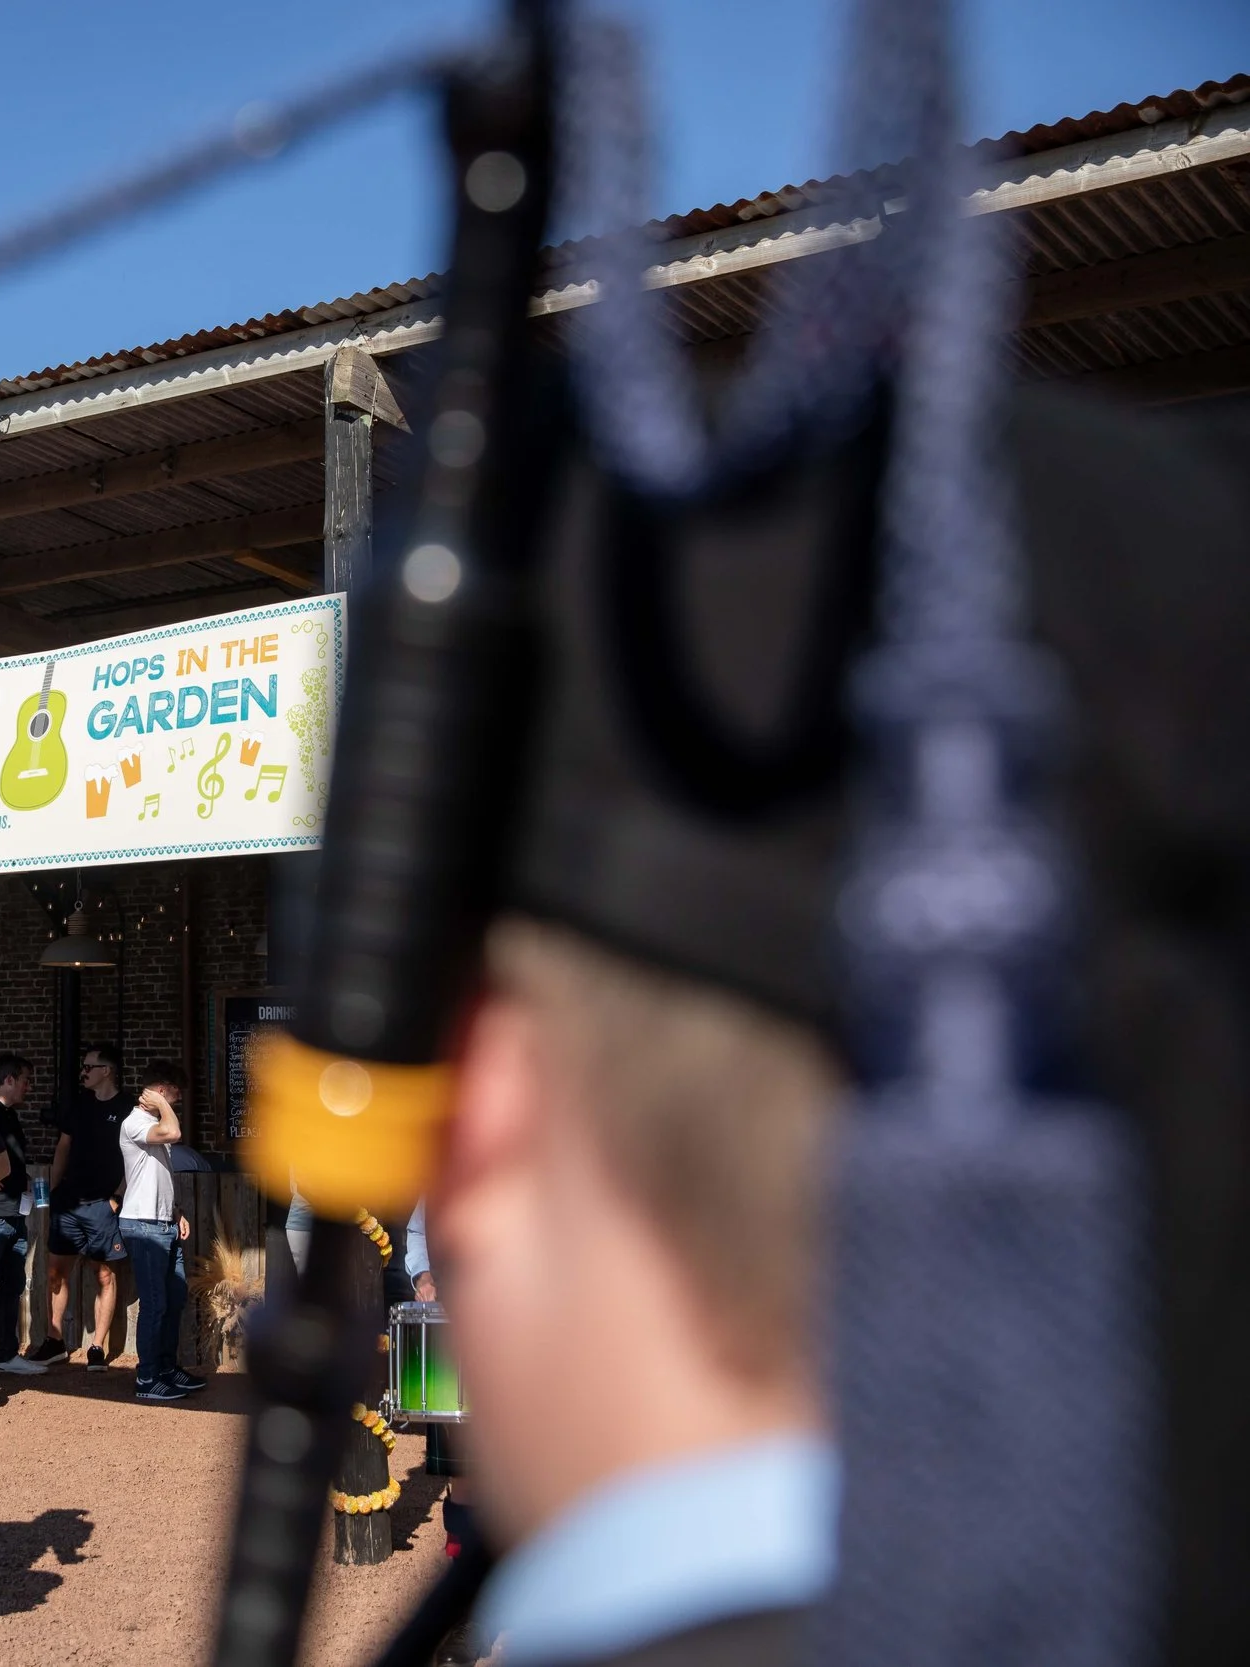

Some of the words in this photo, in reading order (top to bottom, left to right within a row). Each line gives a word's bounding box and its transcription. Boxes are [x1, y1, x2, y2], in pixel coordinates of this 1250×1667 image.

[92, 654, 165, 691] HOPS
[176, 645, 209, 676] IN
[220, 633, 279, 668] THE
[87, 673, 278, 740] GARDEN
